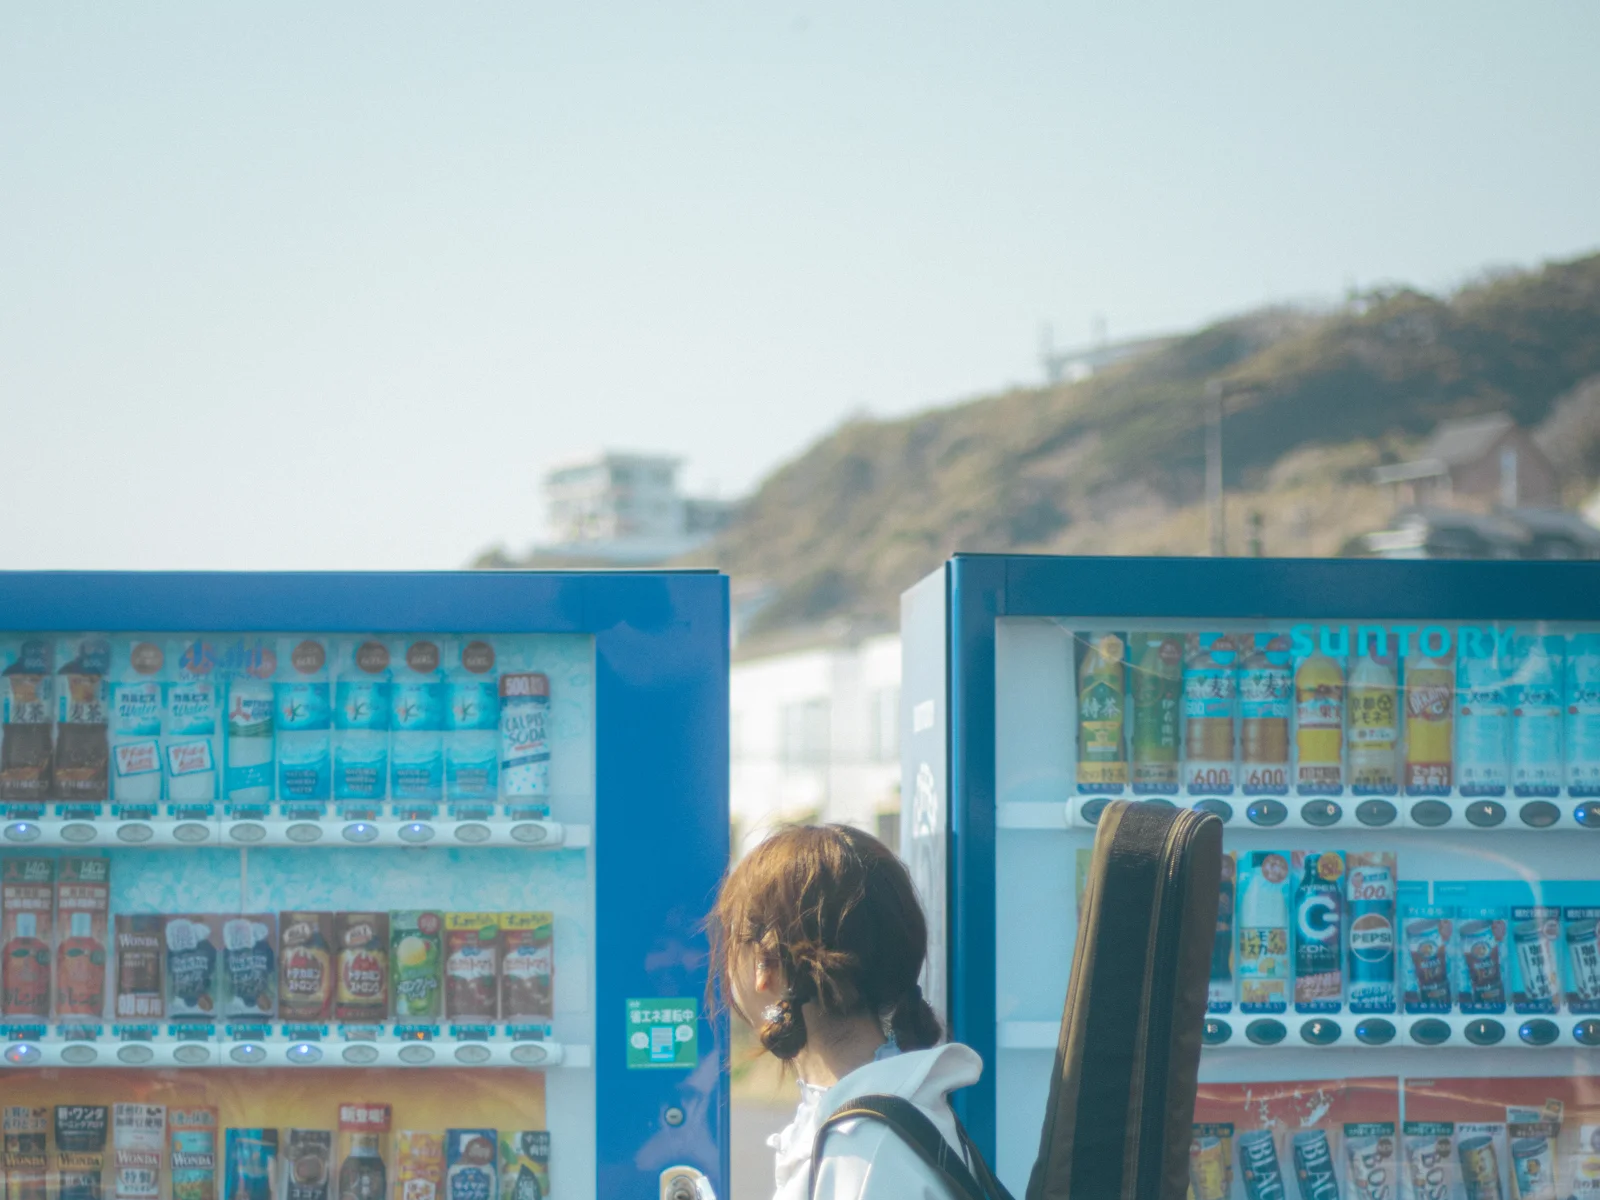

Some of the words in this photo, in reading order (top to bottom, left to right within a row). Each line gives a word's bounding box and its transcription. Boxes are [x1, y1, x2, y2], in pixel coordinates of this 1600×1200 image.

[506, 677, 529, 695] 500
[121, 693, 156, 703] カルピス
[174, 693, 209, 703] カルピス
[119, 704, 157, 717] Water
[172, 704, 209, 717] Water
[1081, 697, 1121, 719] 特茶
[505, 712, 544, 732] CALPIS
[508, 728, 546, 745] SODA
[1194, 769, 1228, 785] 600
[1249, 769, 1283, 785] 600
[1354, 886, 1386, 899] 500
[119, 934, 159, 948] WONDA
[1352, 932, 1391, 943] PEPSI
[630, 1010, 695, 1023] 省エネ運転中
[340, 1106, 385, 1124] 新登場!
[3, 1153, 46, 1168] WONDA
[59, 1153, 100, 1167] WONDA
[116, 1153, 159, 1166] WONDA
[172, 1153, 212, 1166] WONDA
[291, 1189, 323, 1199] ココア
